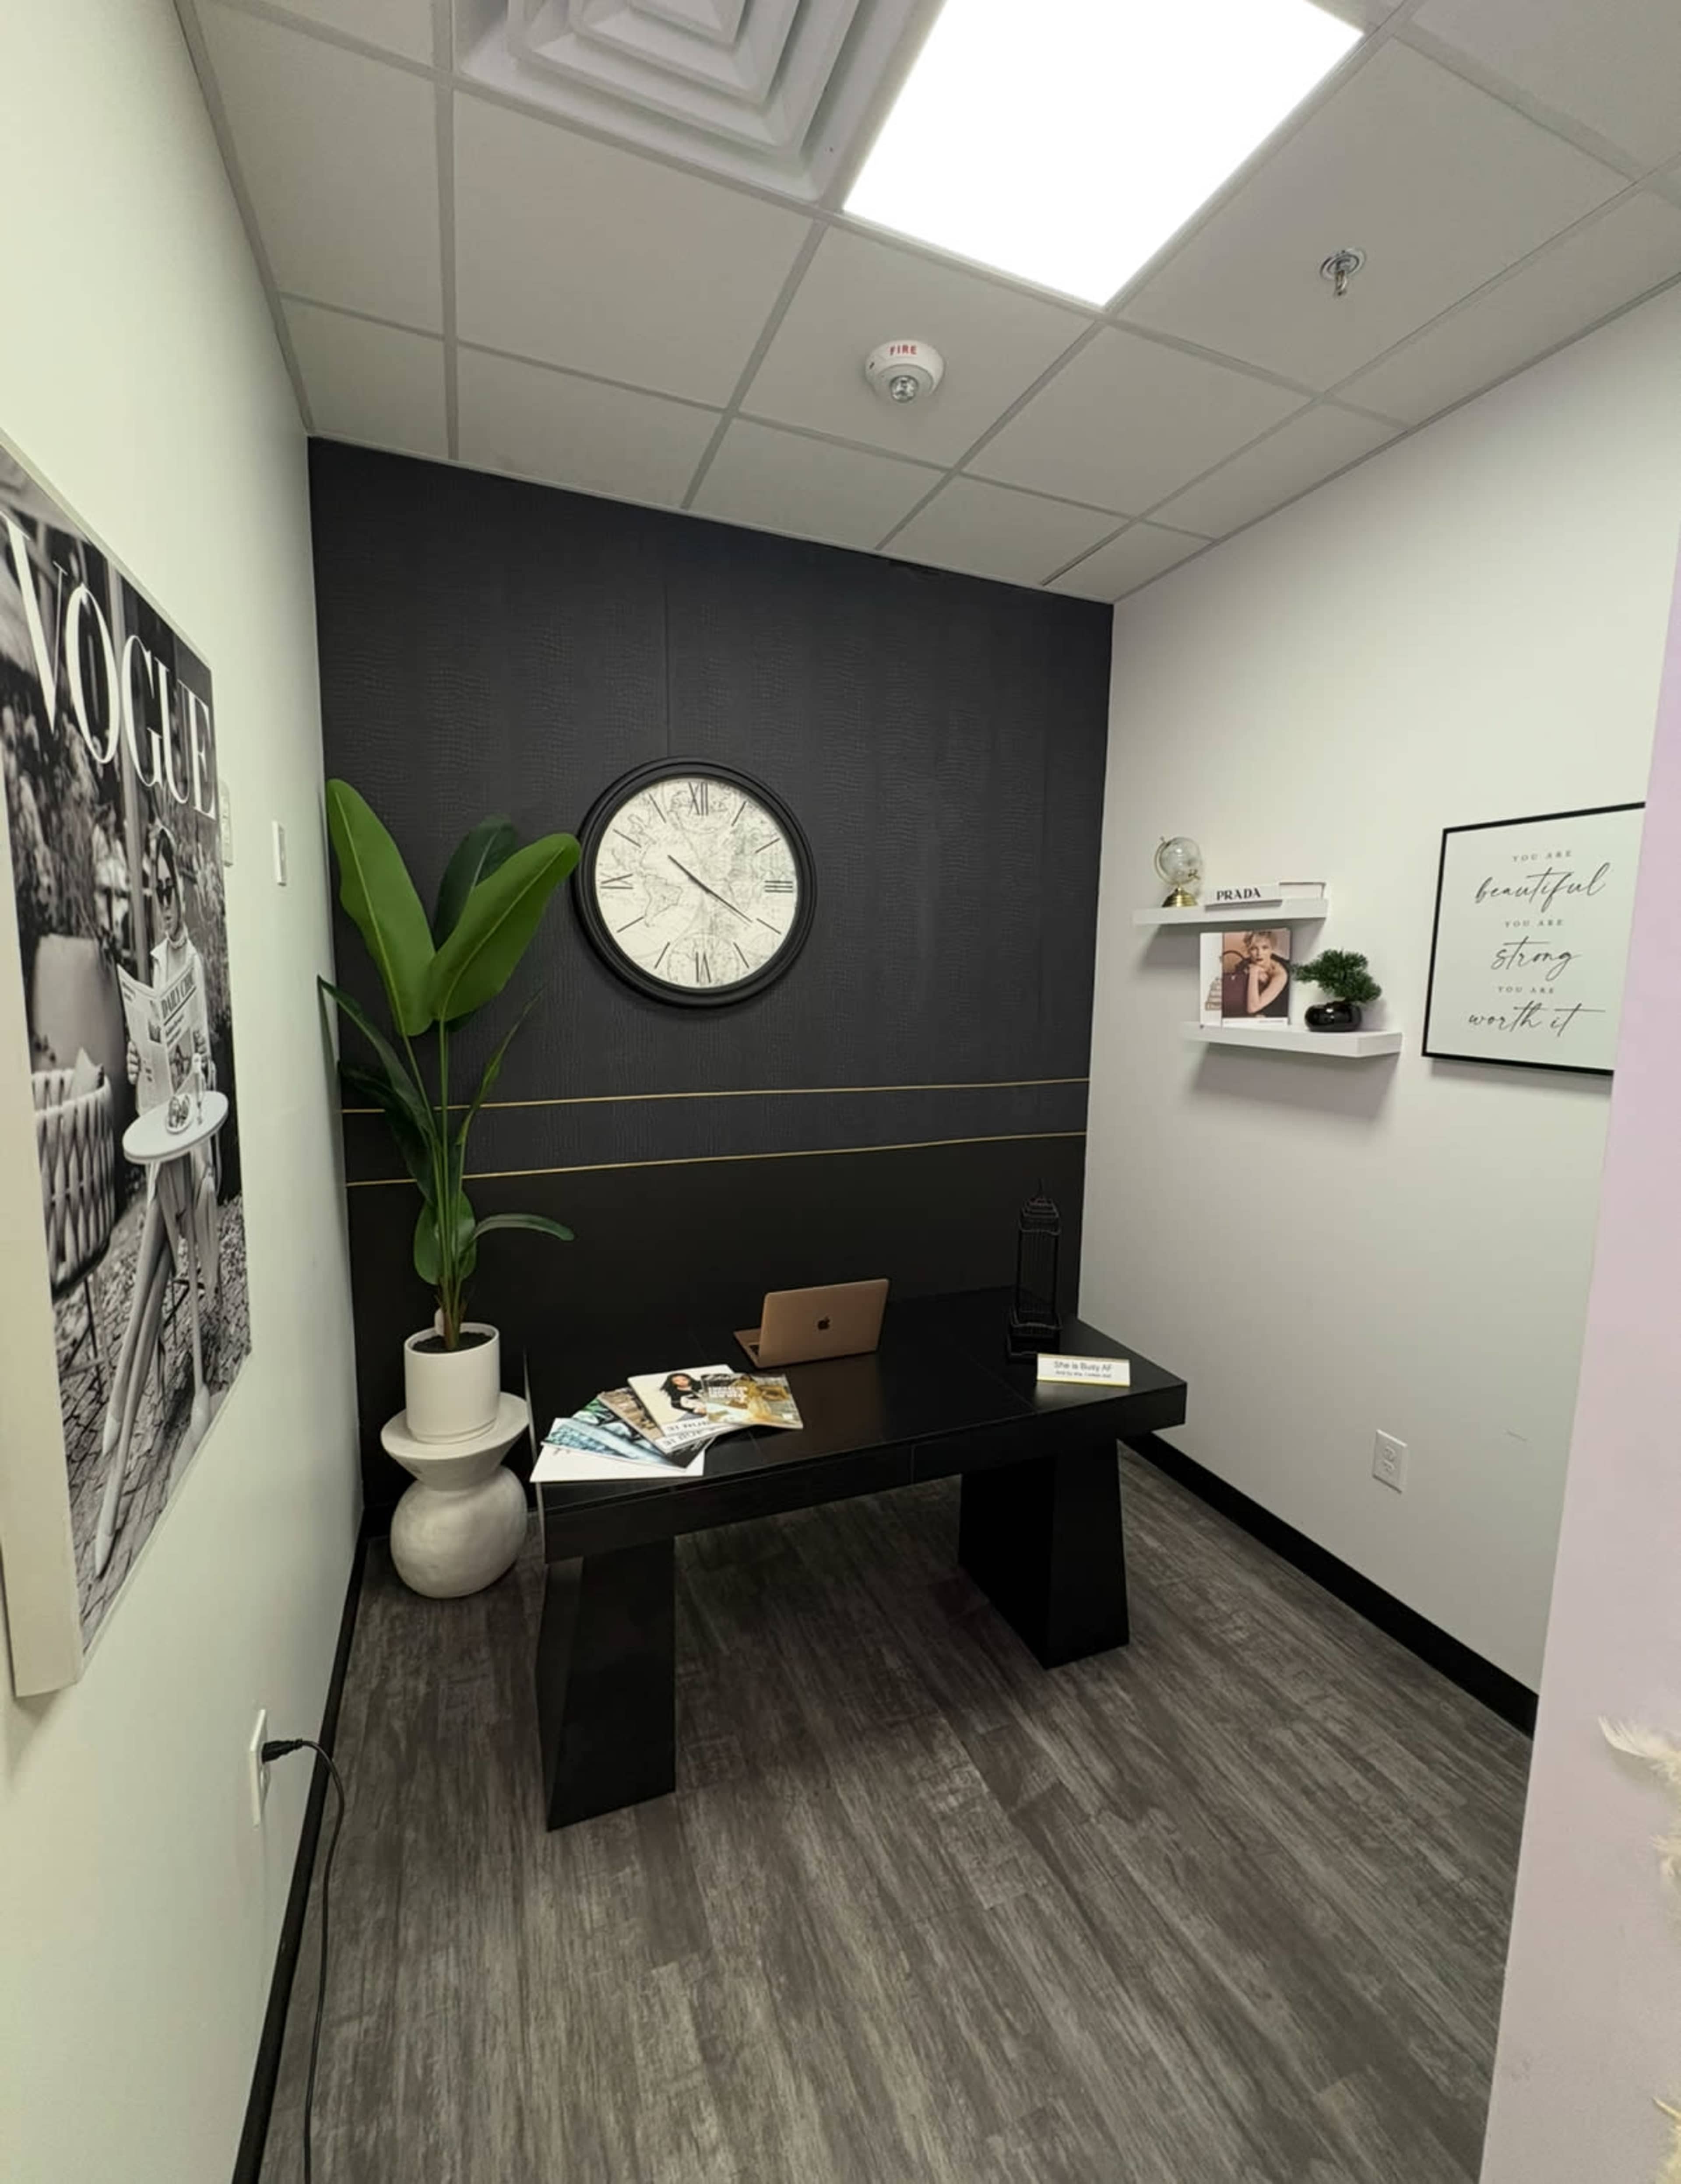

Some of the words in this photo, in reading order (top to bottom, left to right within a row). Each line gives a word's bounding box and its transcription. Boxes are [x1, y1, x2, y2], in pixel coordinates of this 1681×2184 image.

[890, 344, 917, 355] FIRE
[0, 511, 216, 820] VOGUE
[1512, 853, 1538, 862] YOU
[1545, 850, 1572, 860] ARE
[1216, 887, 1261, 900] PRADA
[1474, 862, 1611, 913] beautiful
[1504, 920, 1530, 928] YOU
[1537, 919, 1564, 927] ARE
[1491, 935, 1582, 981] strong
[1497, 985, 1523, 994] YOU
[1530, 986, 1555, 994] ARE
[1468, 1000, 1548, 1032] worth
[1550, 1003, 1606, 1037] it
